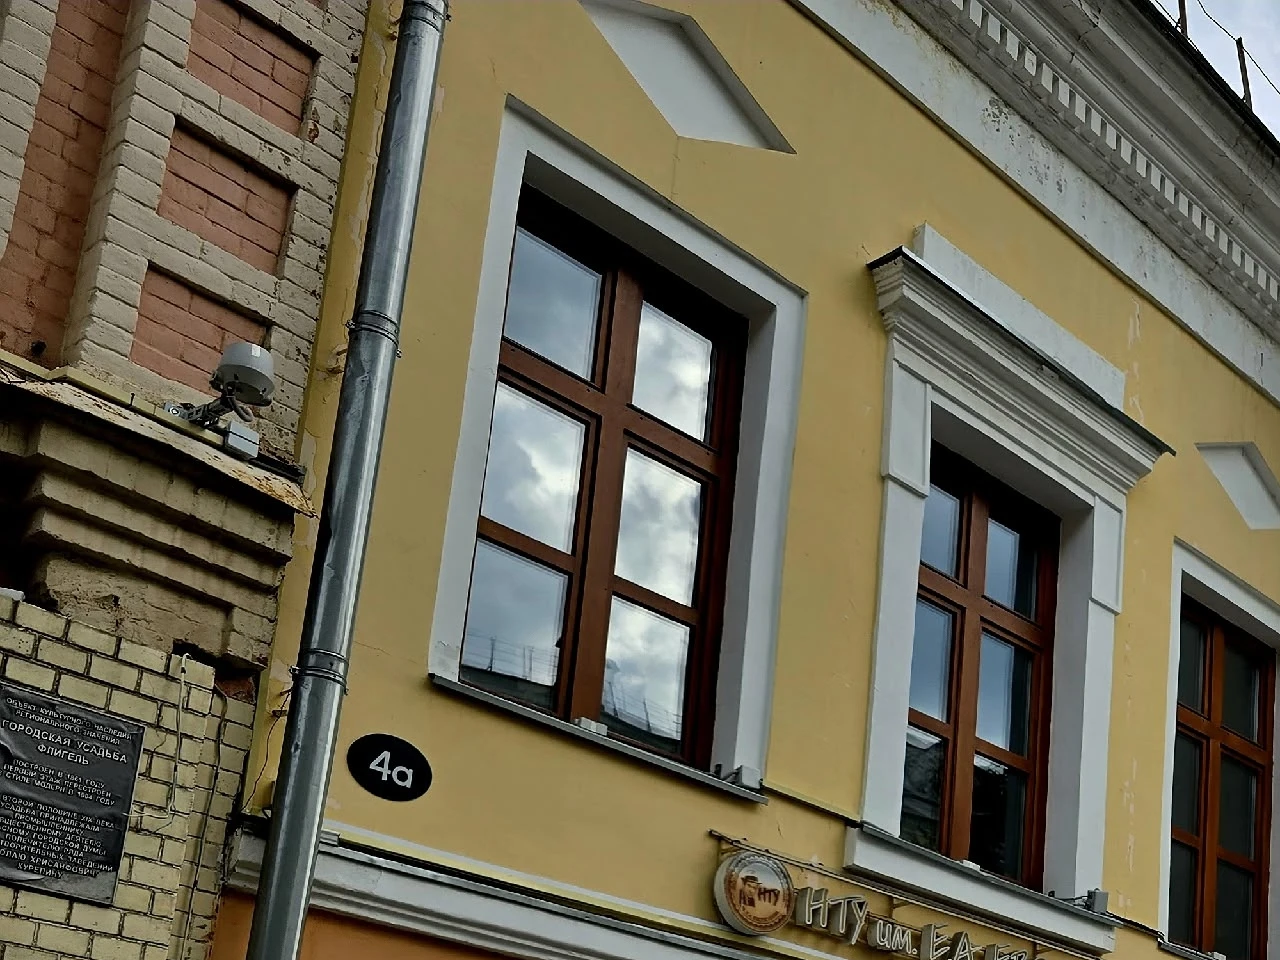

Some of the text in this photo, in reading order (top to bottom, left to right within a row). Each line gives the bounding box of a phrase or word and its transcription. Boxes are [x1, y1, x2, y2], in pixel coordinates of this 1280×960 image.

[2, 719, 127, 764] ГОРОДСКАЯ УСАДЬБА
[37, 743, 89, 766] ФЛИГЕЛЬ
[369, 750, 413, 788] 4а
[757, 886, 781, 907] НТУ
[803, 886, 868, 946] НТУ
[876, 918, 918, 956] им.
